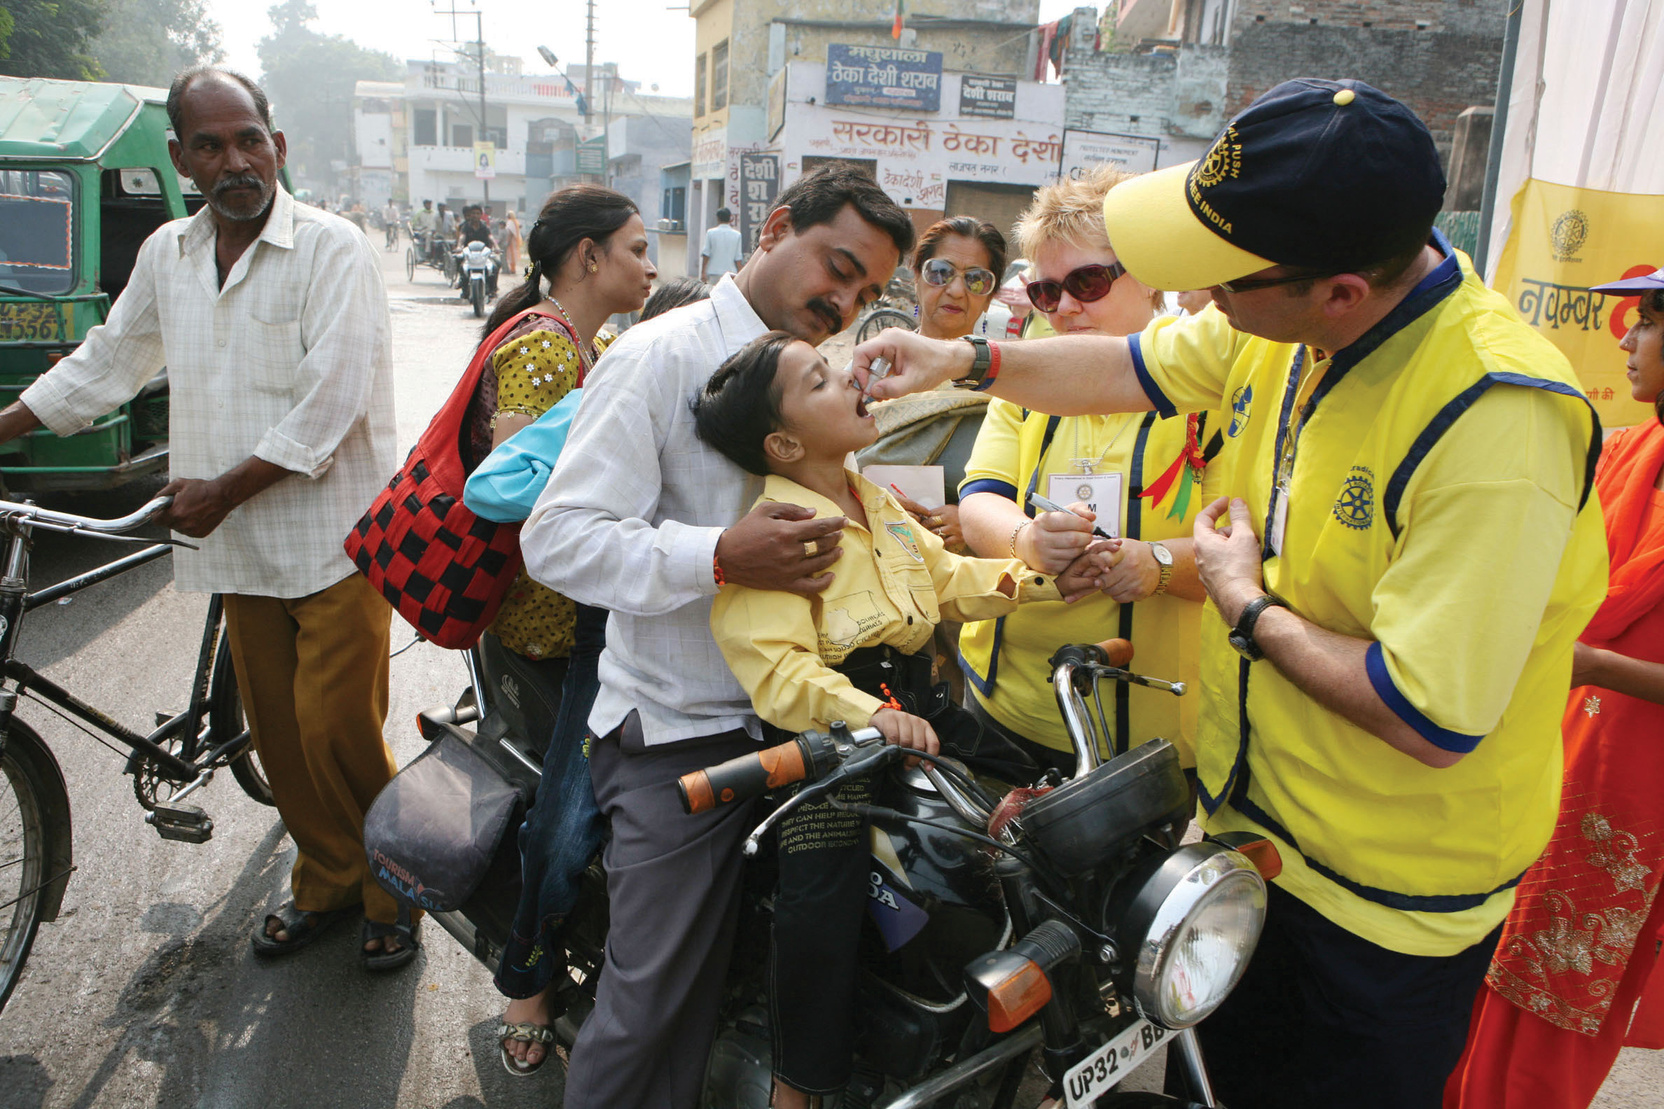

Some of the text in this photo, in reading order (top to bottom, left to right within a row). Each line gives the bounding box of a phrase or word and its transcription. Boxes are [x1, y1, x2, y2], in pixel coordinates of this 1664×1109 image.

[832, 60, 939, 90] ठेका देशी शराब
[831, 120, 1063, 165] सरकारी ठेका देशी
[743, 158, 776, 180] देशी
[1229, 144, 1242, 179] PUSH
[1200, 200, 1233, 235] INDIA
[1518, 278, 1605, 332] नवम्बर
[1602, 387, 1615, 401] की
[796, 812, 813, 822] CAN
[810, 822, 825, 830] THE
[373, 848, 415, 887] TOURISM
[1069, 1047, 1119, 1102] UP32
